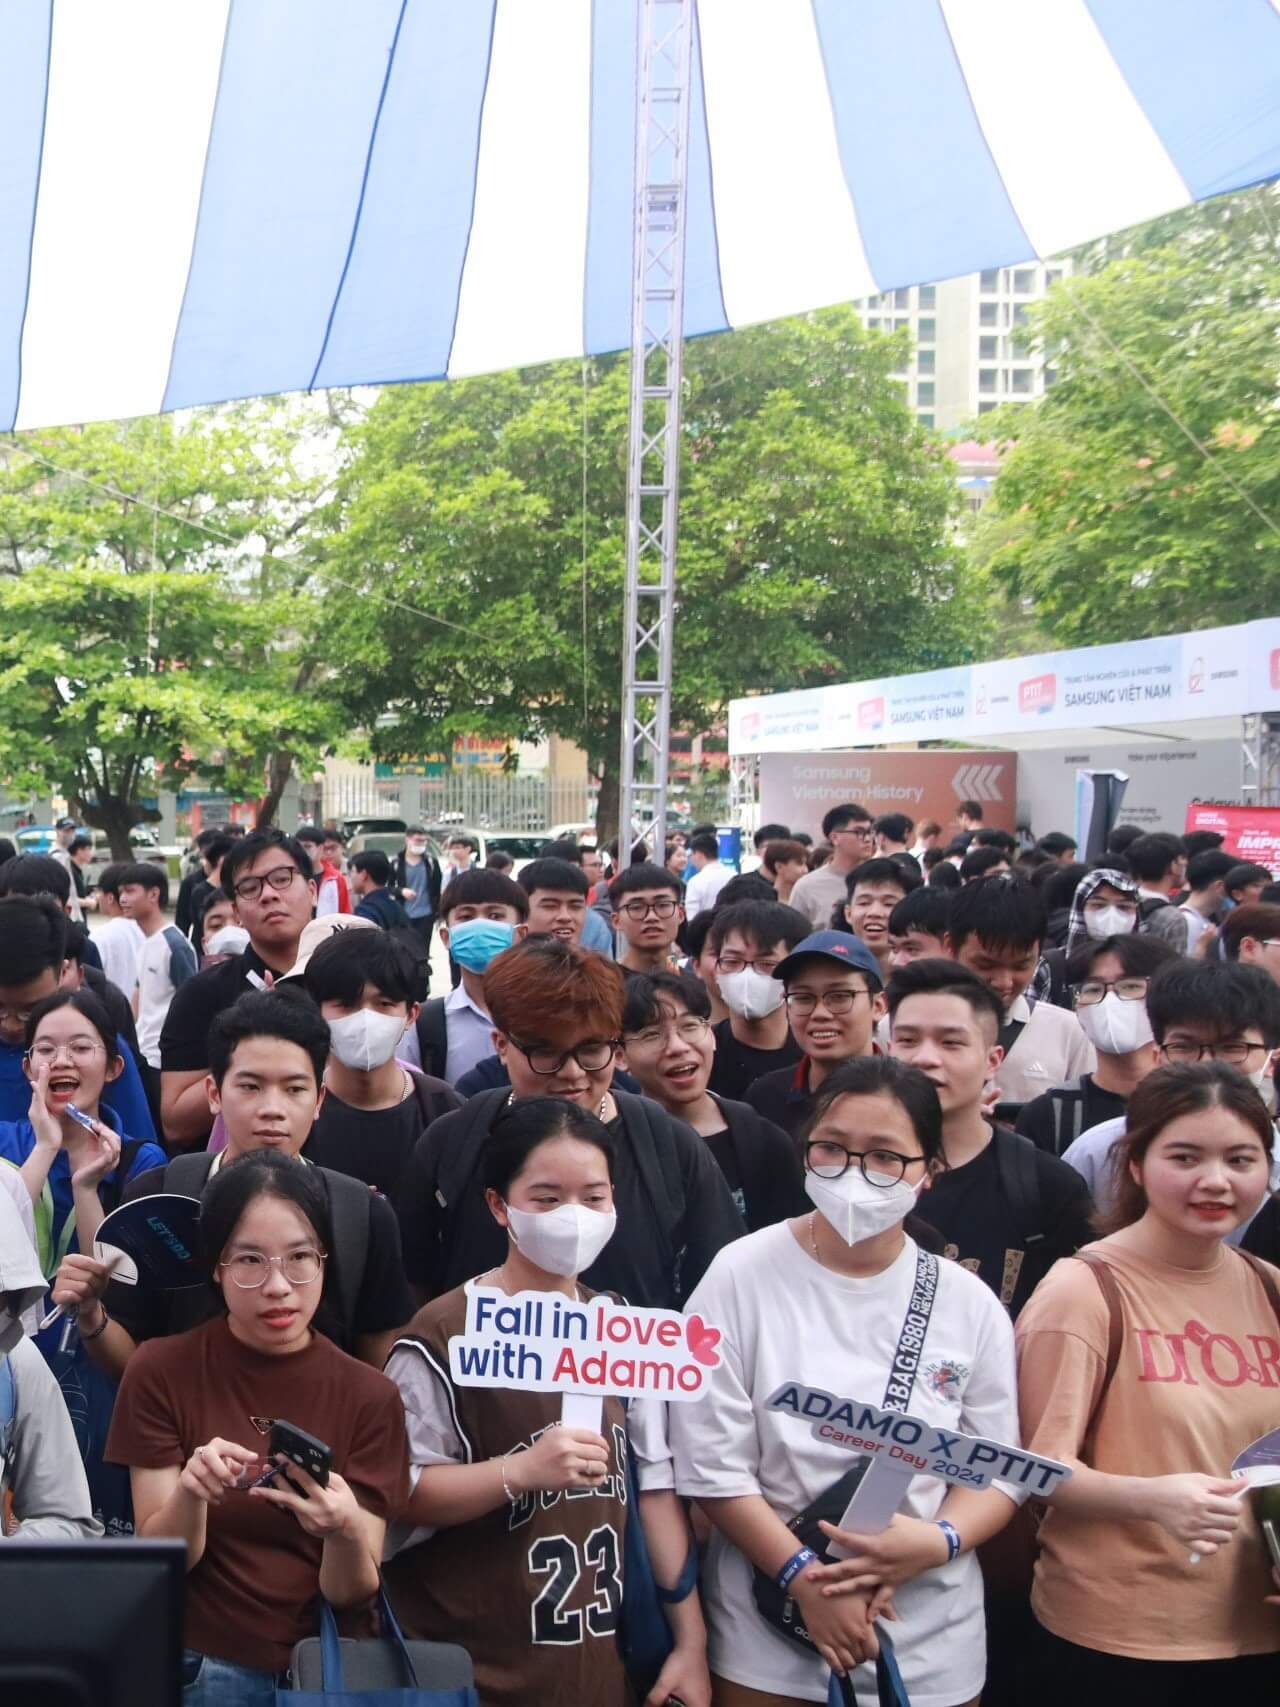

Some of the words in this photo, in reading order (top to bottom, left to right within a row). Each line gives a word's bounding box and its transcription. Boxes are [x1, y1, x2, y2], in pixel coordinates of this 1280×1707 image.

[1064, 689, 1115, 708] SAMSUNG
[1119, 684, 1142, 704] VIỆT
[1145, 684, 1172, 700] NAM
[791, 765, 871, 783] Samsung
[791, 785, 865, 801] Vietnam
[867, 785, 924, 802] History
[474, 1296, 543, 1337] Fall
[552, 1302, 588, 1341] in
[595, 1306, 682, 1347] love
[458, 1340, 542, 1381] with
[551, 1347, 703, 1392] Adamo
[773, 1387, 923, 1446] ADAMO
[928, 1433, 961, 1459] X
[965, 1442, 1065, 1490] PTIT
[819, 1424, 885, 1453] Career
[887, 1444, 928, 1471] Day
[931, 1459, 986, 1486] 2024
[528, 1523, 624, 1645] 23
